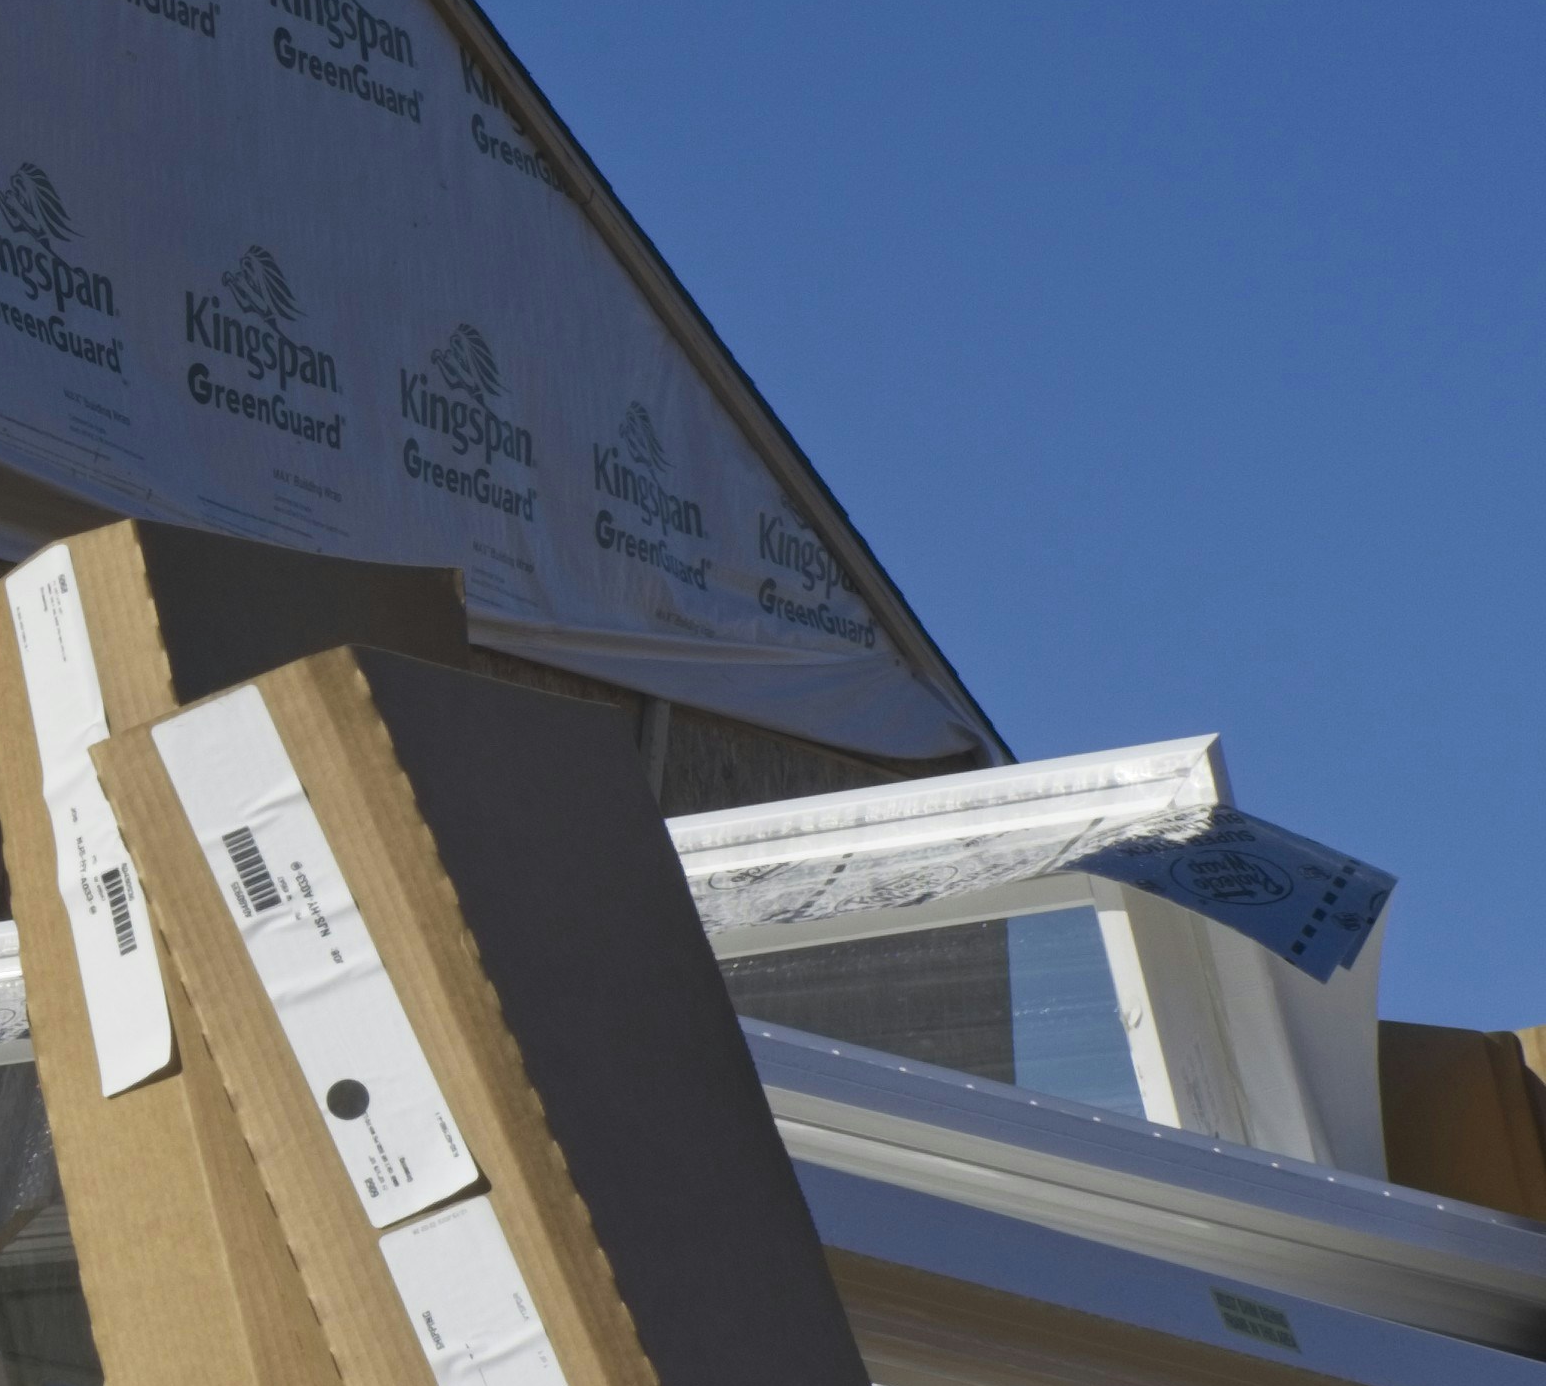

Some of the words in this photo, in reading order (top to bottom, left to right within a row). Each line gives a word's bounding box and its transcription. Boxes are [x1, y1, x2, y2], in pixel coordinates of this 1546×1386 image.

[272, 25, 422, 125] GreenGuard
[186, 290, 338, 395] Kingspan
[188, 362, 344, 451] GreenGuard
[399, 366, 535, 470] Kingspan
[402, 439, 535, 524] GreenGuard
[593, 441, 704, 541] Kingspan
[595, 511, 708, 592] GreenGuard
[759, 576, 877, 650] GreenGuard
